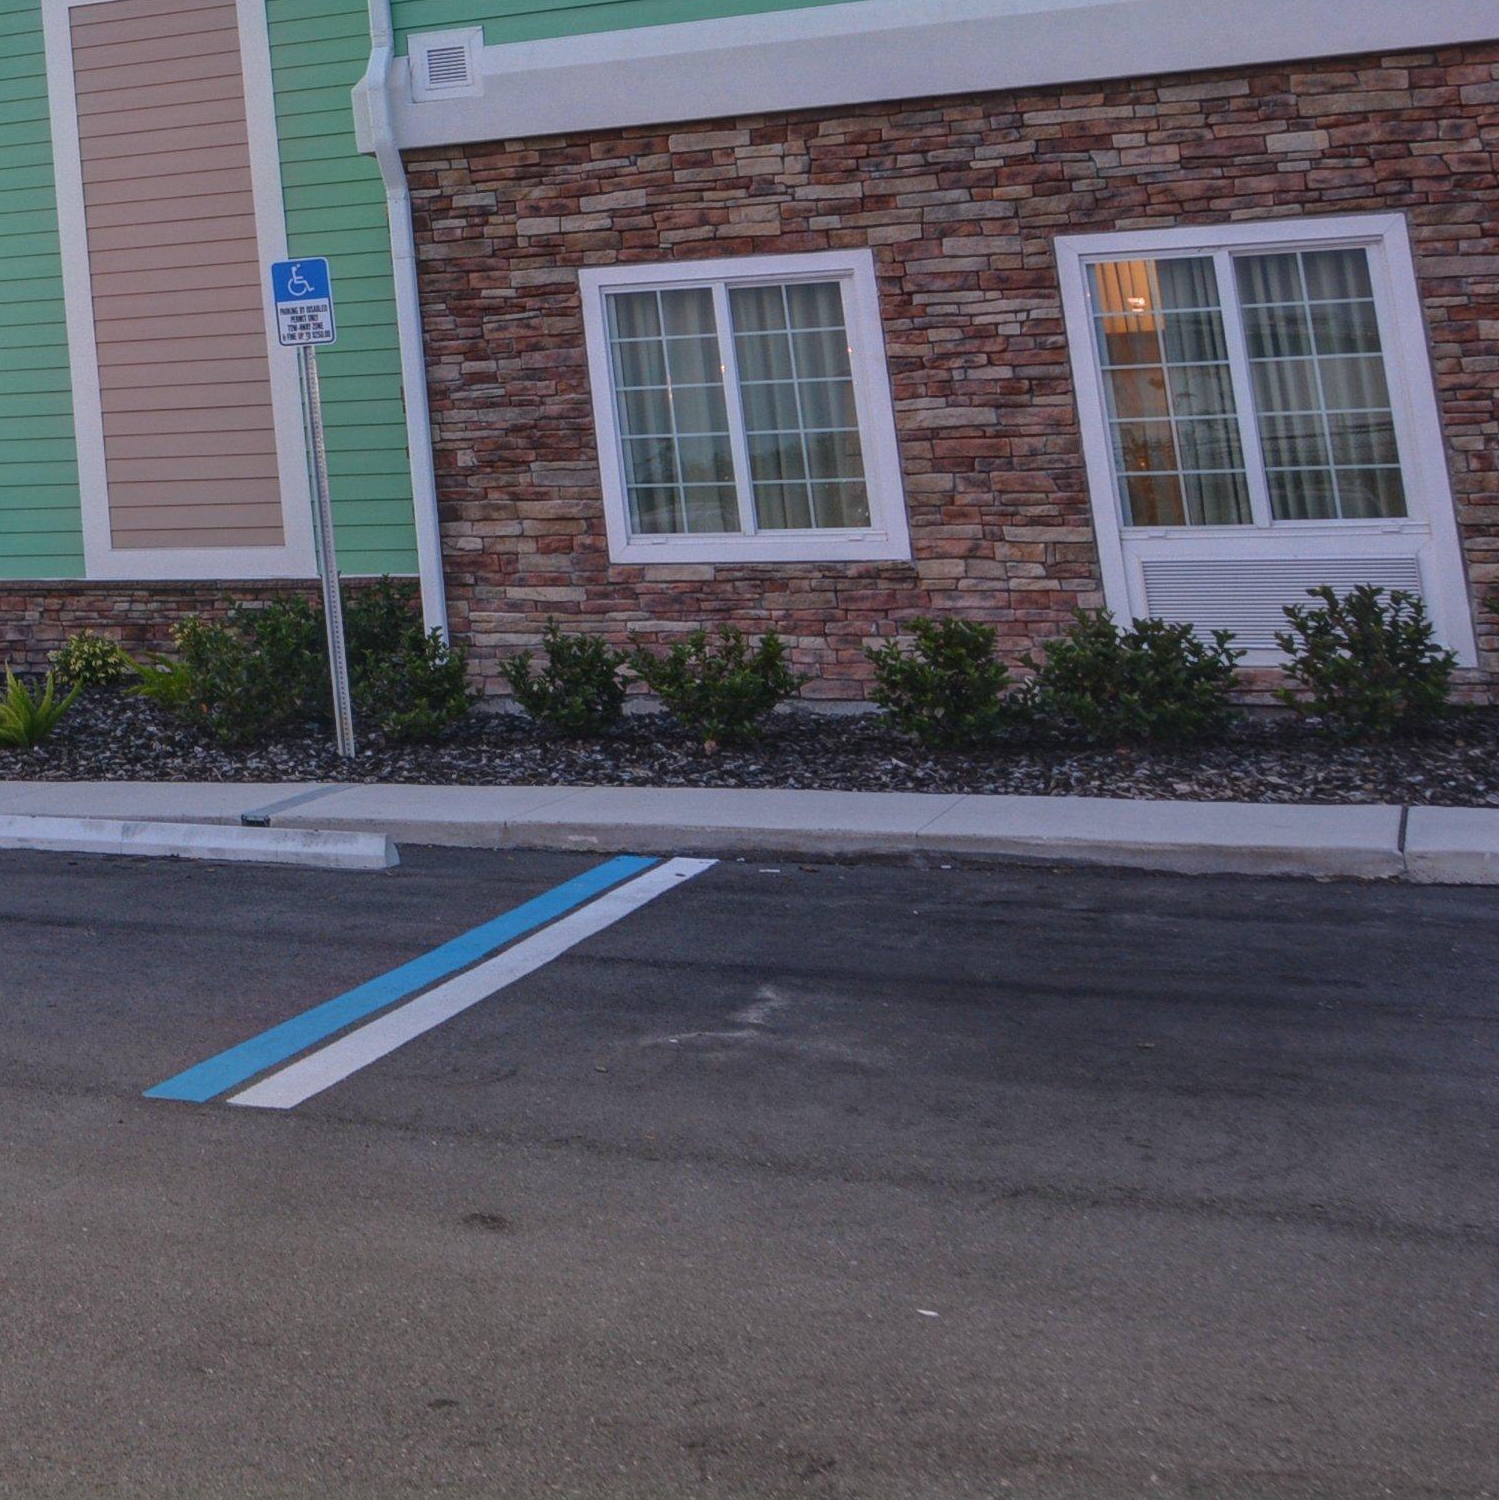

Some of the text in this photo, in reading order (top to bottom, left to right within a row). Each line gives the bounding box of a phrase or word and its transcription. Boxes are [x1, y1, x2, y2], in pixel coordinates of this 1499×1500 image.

[279, 304, 328, 316] PARKING BY DISABLED
[290, 315, 307, 323] PERMIT
[312, 321, 324, 330] ZONE
[287, 332, 297, 340] FINE
